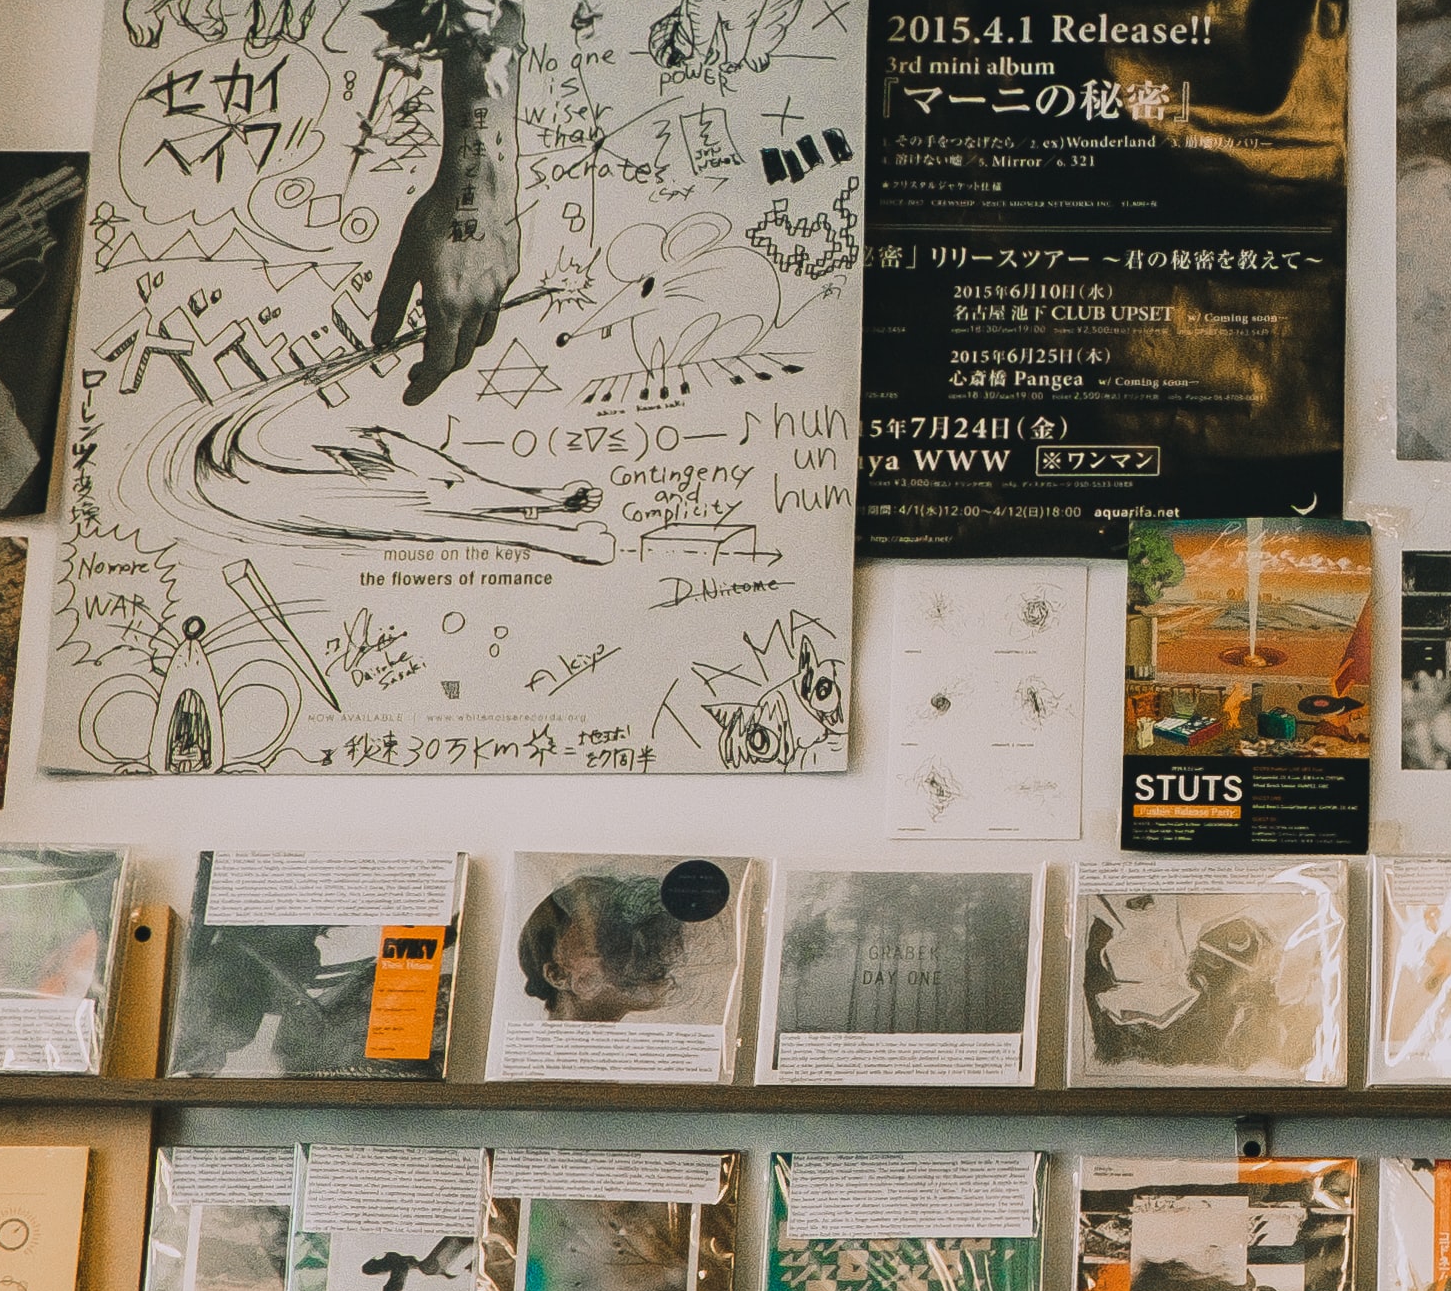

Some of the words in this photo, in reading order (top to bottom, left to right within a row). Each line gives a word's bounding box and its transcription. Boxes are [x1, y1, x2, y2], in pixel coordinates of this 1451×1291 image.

[887, 14, 1034, 46] 2015.4.1
[1051, 13, 1214, 46] Release!!
[528, 45, 558, 73] No
[885, 55, 924, 76] 3rd
[928, 55, 980, 75] mini
[985, 55, 1056, 76] album
[549, 75, 581, 99] is
[882, 76, 1191, 123] 『マーニの秘密』
[991, 154, 1043, 168] Mirror
[1070, 154, 1097, 168] 321
[953, 305, 1006, 323] 名古屋
[1050, 305, 1107, 323] CLUB
[1111, 305, 1175, 323] UPSET
[1014, 370, 1084, 391] Pangea
[913, 449, 1011, 473] WWW
[610, 464, 756, 491] Contingency
[654, 481, 702, 505] and
[622, 500, 744, 532] Complicity
[1093, 506, 1181, 521] aquarifa.net
[383, 548, 436, 562] mouse
[441, 548, 461, 561] on
[465, 546, 491, 561] the
[495, 546, 532, 564] keys
[359, 571, 387, 587] the
[391, 570, 453, 587] flowers
[458, 570, 476, 586] of
[480, 571, 554, 587] romance
[1135, 774, 1244, 803] STUTS
[868, 945, 940, 961] GRABEK
[862, 969, 897, 986] DAY
[907, 969, 942, 986] ONE
